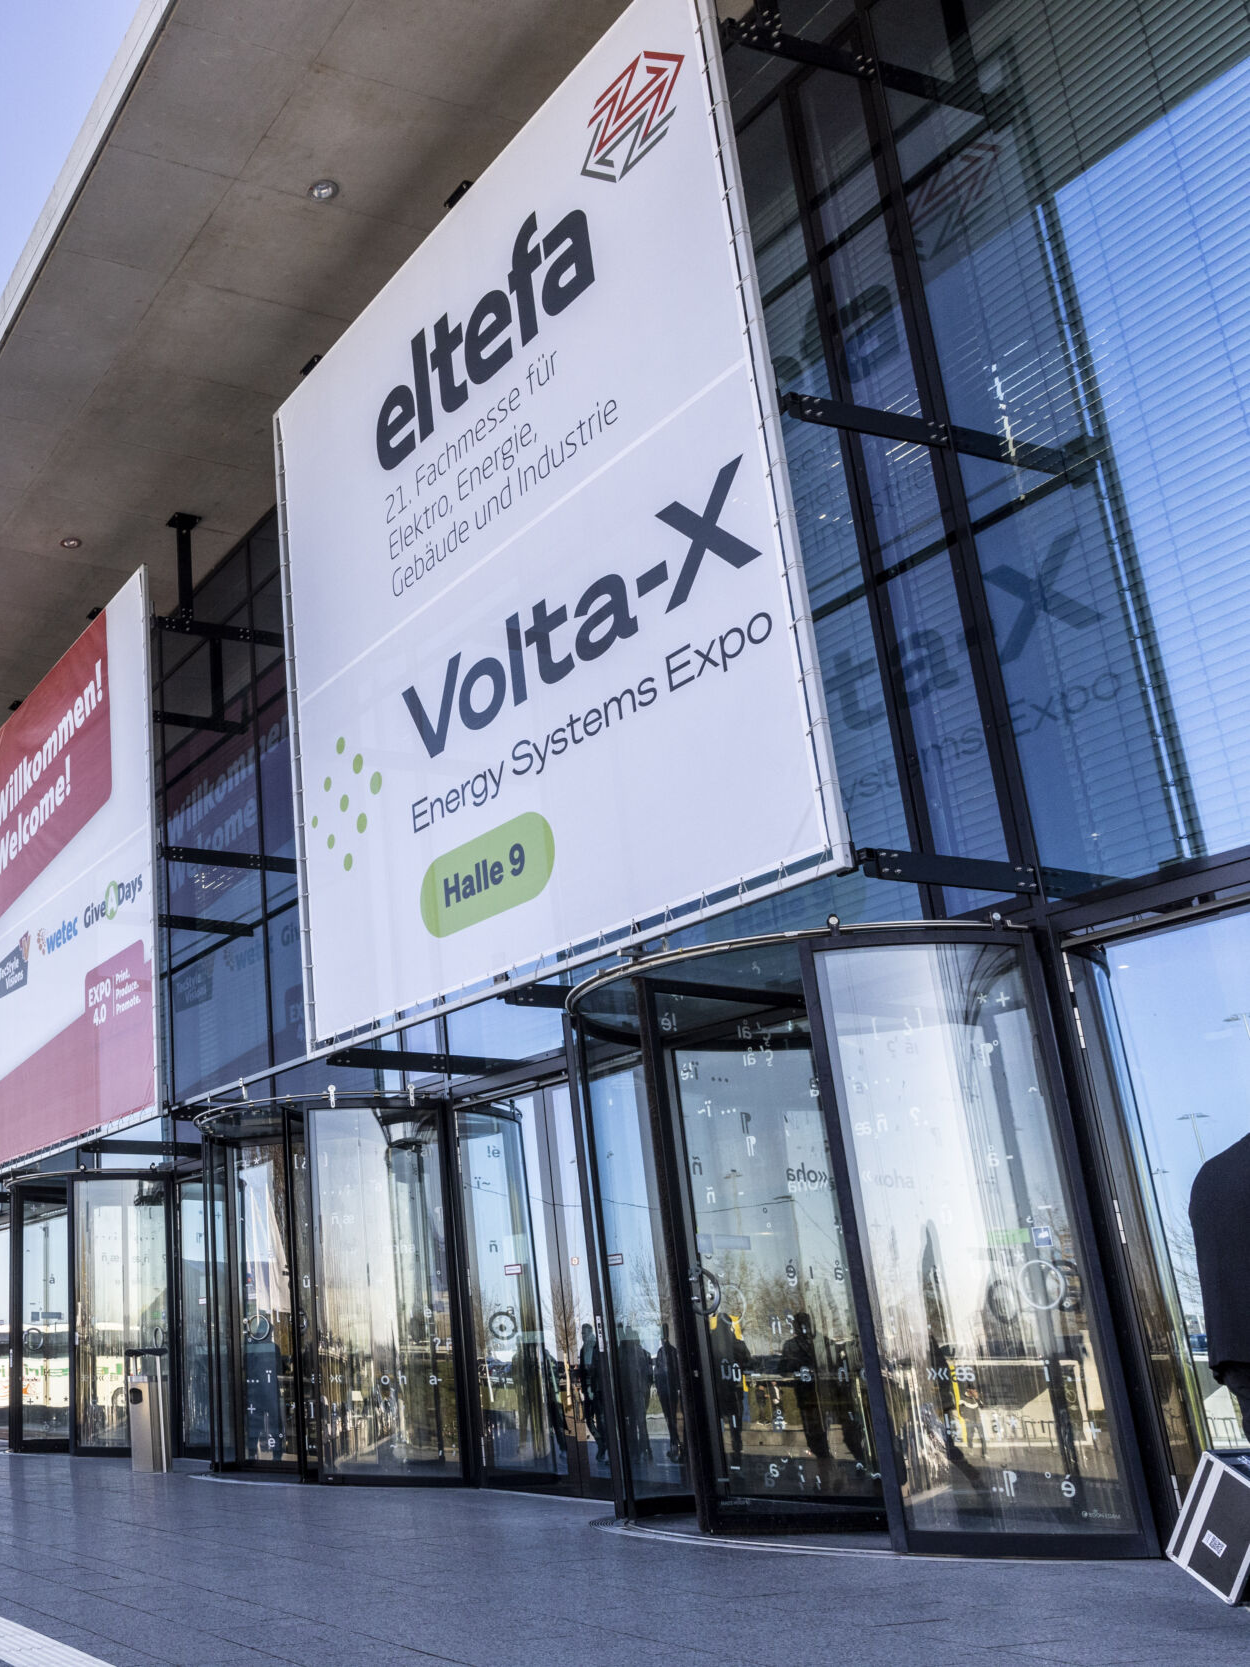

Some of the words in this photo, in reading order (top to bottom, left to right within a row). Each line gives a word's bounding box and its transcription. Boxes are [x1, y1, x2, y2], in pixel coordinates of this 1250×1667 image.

[376, 209, 595, 470] eltefa
[385, 488, 414, 526] 21.
[415, 386, 522, 489] Fachmesse
[525, 348, 560, 394] für
[388, 490, 453, 561] Elektro,
[457, 424, 539, 500] Energie,
[391, 525, 471, 598] Gebäude
[475, 487, 513, 540] und
[517, 396, 621, 501] Industrie
[402, 454, 762, 759] Volta-X
[411, 757, 505, 833] Energy
[512, 676, 658, 776] Systems
[666, 611, 773, 695] Expo
[443, 853, 504, 908] Halle
[509, 843, 526, 876] 9
[46, 916, 78, 955] wetec
[5, 970, 24, 990] Visions
[88, 978, 111, 1008] EXPO
[115, 968, 131, 985] Print.
[115, 980, 140, 1001] Produce.
[93, 1003, 107, 1026] 4.0
[116, 994, 142, 1015] Promote.
